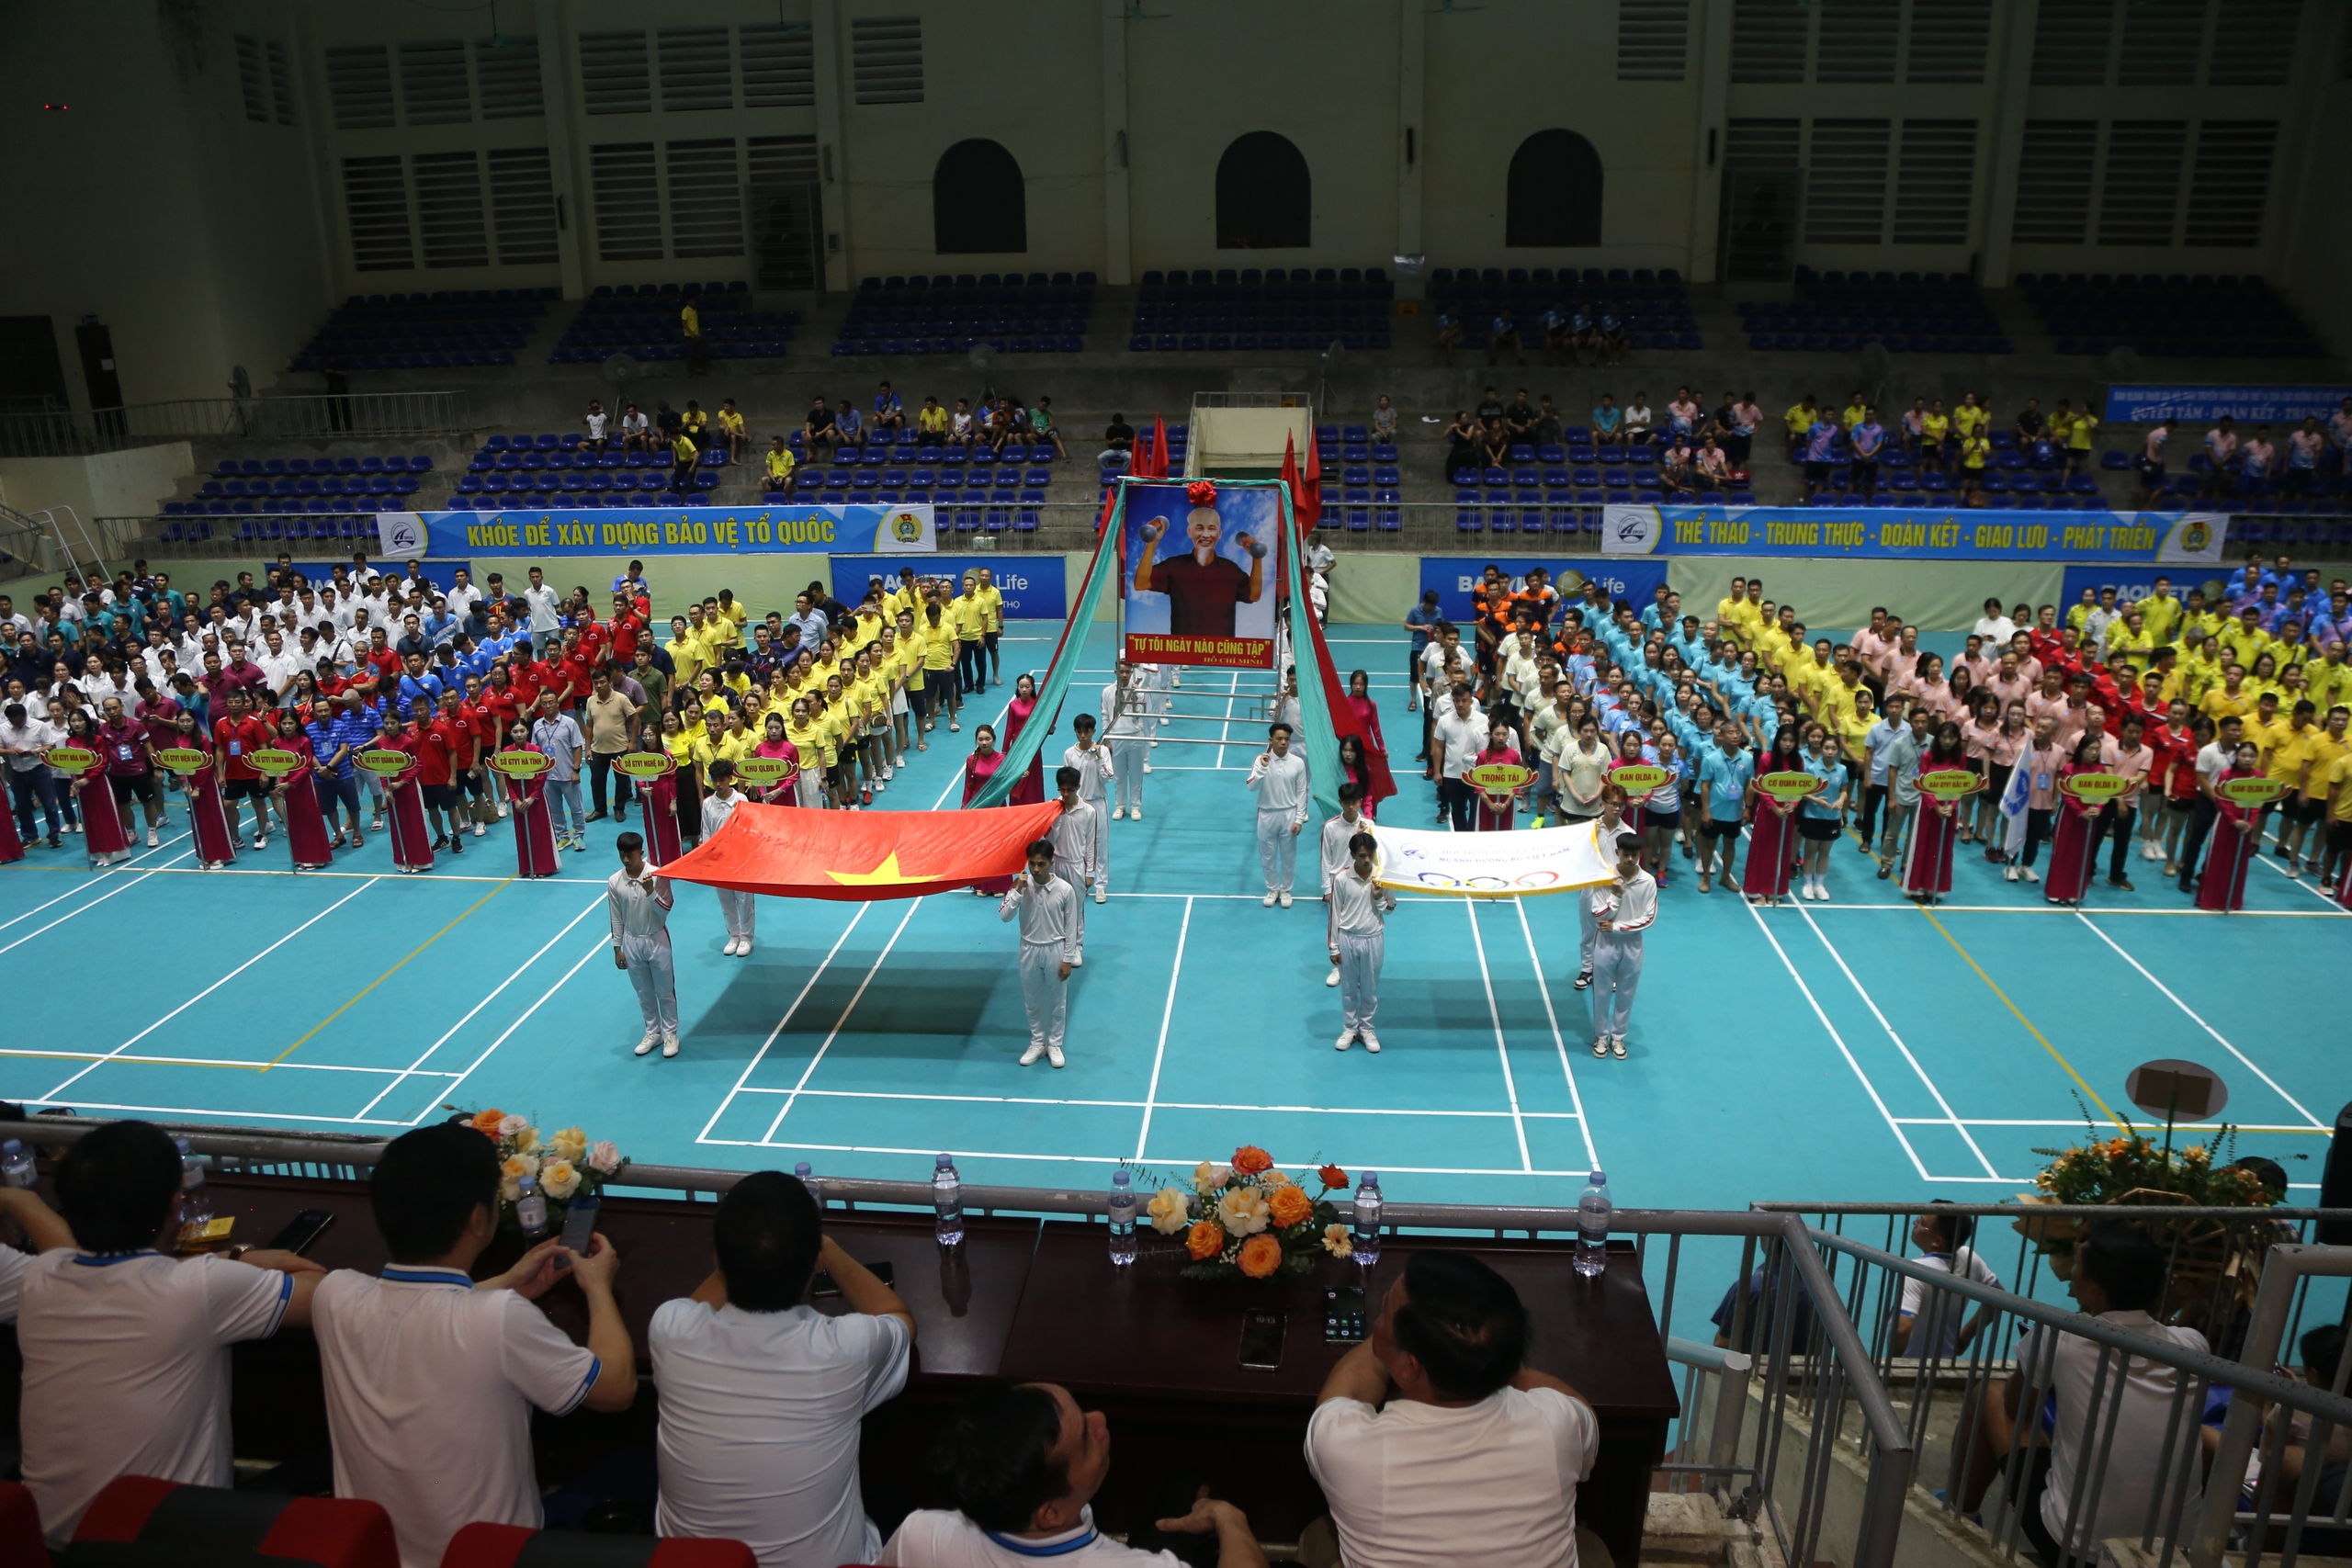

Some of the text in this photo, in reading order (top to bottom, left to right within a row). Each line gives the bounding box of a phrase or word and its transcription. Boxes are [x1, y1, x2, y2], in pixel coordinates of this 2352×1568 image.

[467, 513, 835, 549] KHỎE ĐỂ XÂY DỰNG BẢO VỆ TỔ QUỐC
[1674, 512, 1706, 544] THỂ
[1709, 521, 1749, 545] THAO
[1766, 521, 1819, 546] TRUNG
[1824, 521, 1865, 551] THỰC
[1880, 518, 1926, 547] ĐOÀN
[1930, 517, 1961, 548] KẾT
[1975, 525, 2013, 548] GIAO
[2017, 525, 2049, 549] LƯU
[2063, 522, 2106, 549] PHÁT
[2109, 518, 2156, 550] TRIỂN
[996, 574, 1028, 591] Life
[1148, 637, 1163, 651] TÔI
[1166, 637, 1192, 652] NGÀY
[1194, 638, 1215, 654] NÀO
[1217, 639, 1244, 655] CŨNG
[500, 756, 507, 765] SỞ
[522, 757, 529, 765] HÀ
[625, 759, 631, 767] SỞ
[644, 759, 657, 768] NGHỆ
[1481, 773, 1520, 784] TRỌNG TÀI
[1779, 779, 1797, 787] QUAN
[1798, 780, 1813, 788] CỤC
[1550, 847, 1570, 857] NAM
